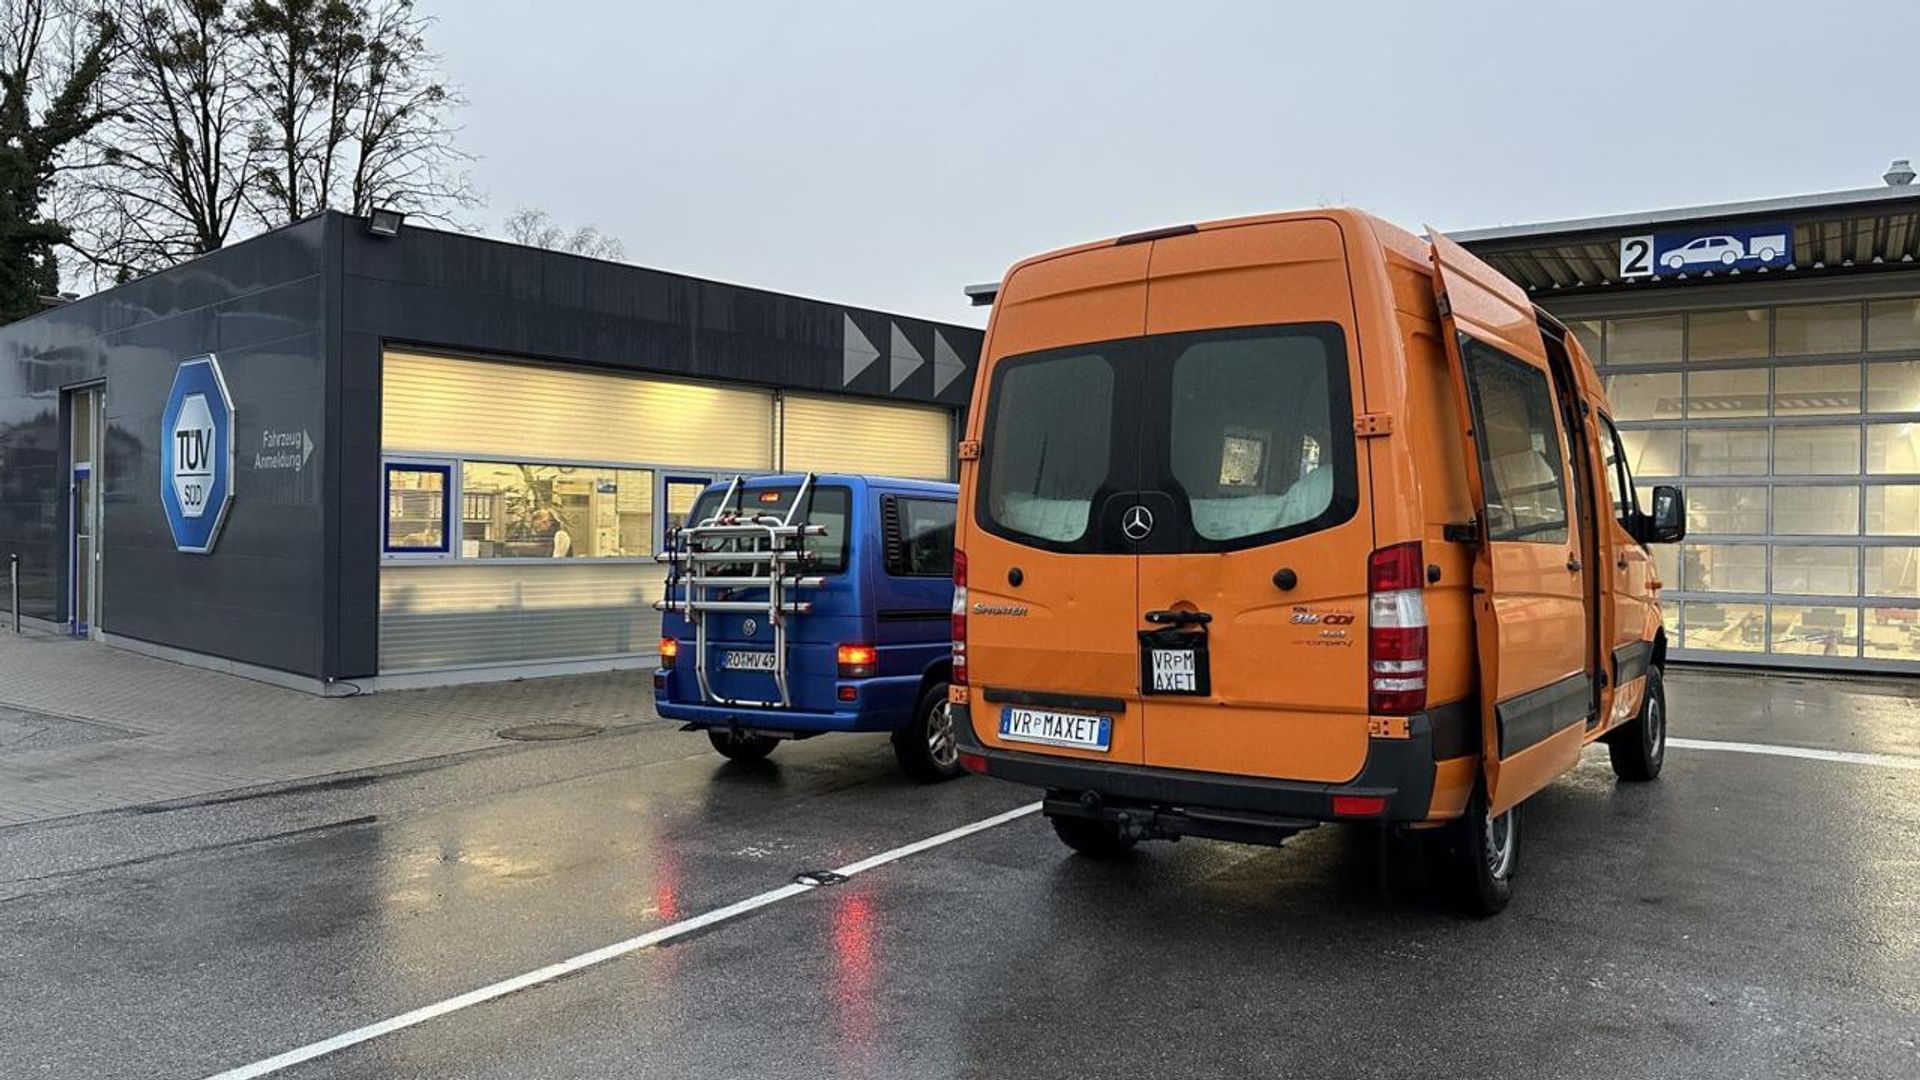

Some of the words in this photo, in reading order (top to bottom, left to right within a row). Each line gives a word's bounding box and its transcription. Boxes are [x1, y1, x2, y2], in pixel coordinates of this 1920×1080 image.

[1624, 240, 1649, 273] 2
[177, 428, 212, 470] TÜV
[263, 430, 302, 449] Fahrzeug
[254, 451, 302, 472] Anmeldung
[1322, 614, 1356, 625] CDI
